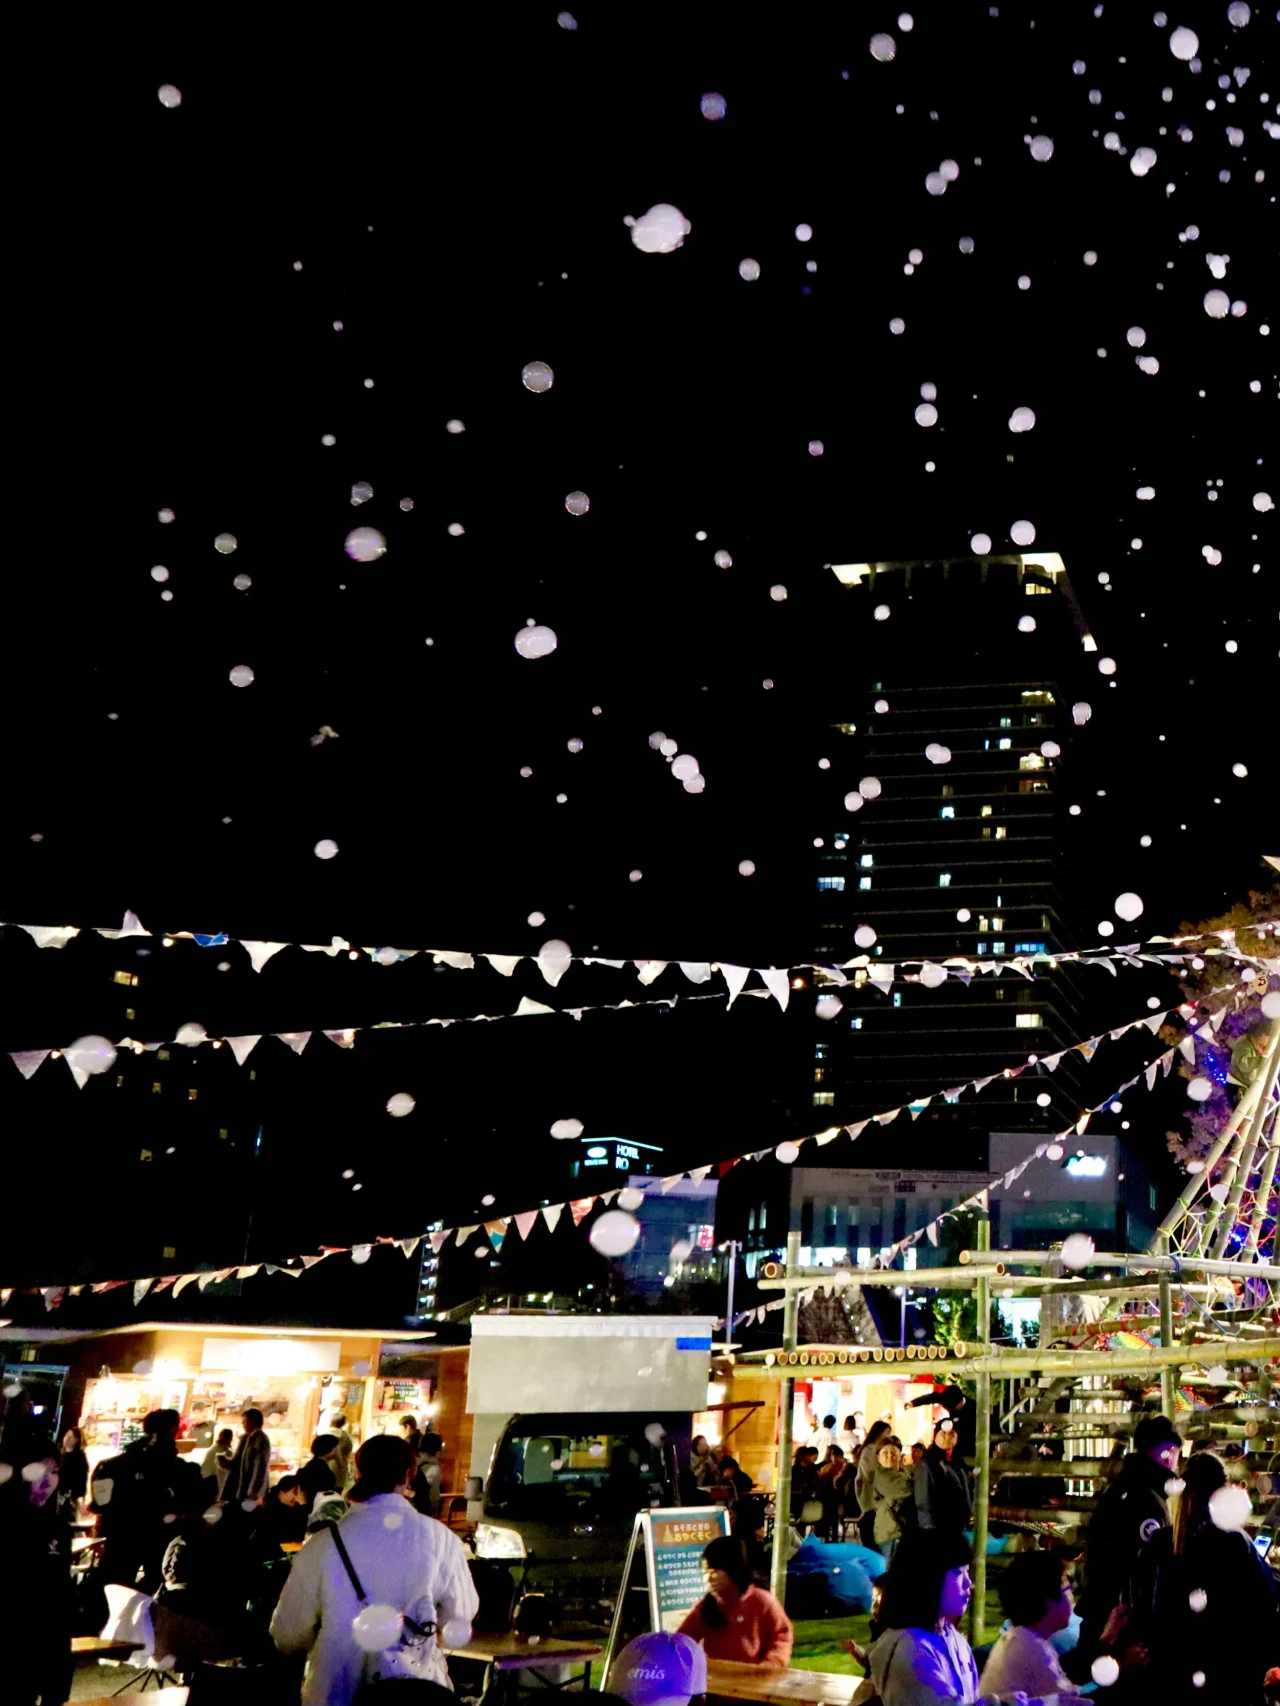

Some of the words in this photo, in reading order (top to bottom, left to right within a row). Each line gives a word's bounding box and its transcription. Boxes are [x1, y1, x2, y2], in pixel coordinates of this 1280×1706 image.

[616, 1144, 640, 1159] HOTEL
[674, 1531, 711, 1542] おやくそく
[627, 1665, 665, 1680] emis
